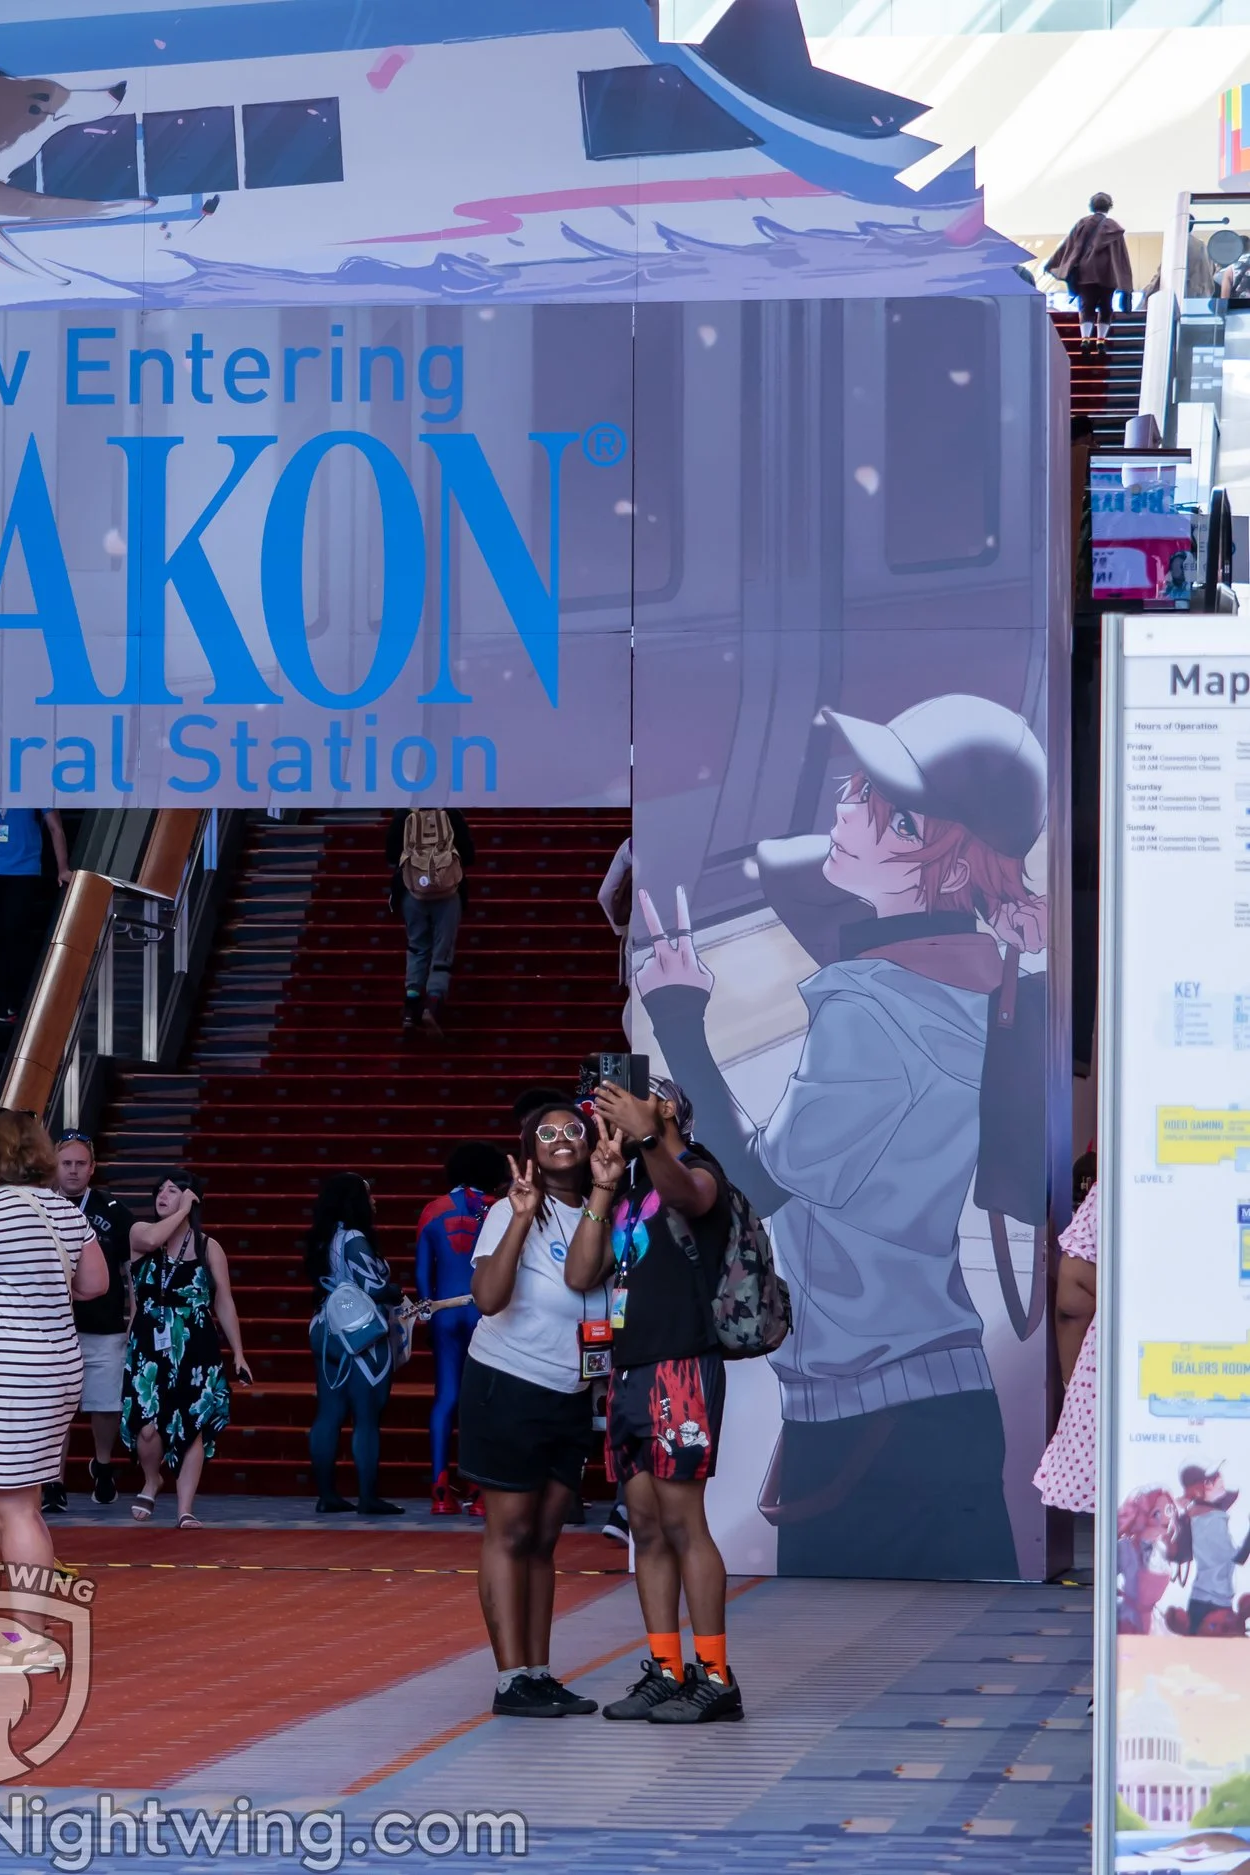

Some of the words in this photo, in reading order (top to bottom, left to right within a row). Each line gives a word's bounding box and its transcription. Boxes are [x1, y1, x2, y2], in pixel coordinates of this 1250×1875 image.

[66, 323, 464, 424] Entering
[1134, 722, 1161, 732] Hours
[1163, 722, 1173, 732] of
[1174, 722, 1218, 733] Operation
[169, 713, 497, 793] Station
[1126, 743, 1153, 752] Friday
[1126, 782, 1162, 792] Saturday
[1126, 823, 1156, 832] Sunday
[1174, 981, 1201, 999] KEY
[1164, 1119, 1188, 1131] VIDEO
[1190, 1119, 1224, 1131] GAMING
[1134, 1174, 1165, 1184] LEVEL
[1167, 1174, 1173, 1184] 2
[1171, 1361, 1219, 1376] DEALERS
[1129, 1433, 1166, 1444] LOWER
[1168, 1433, 1201, 1444] LEVEL
